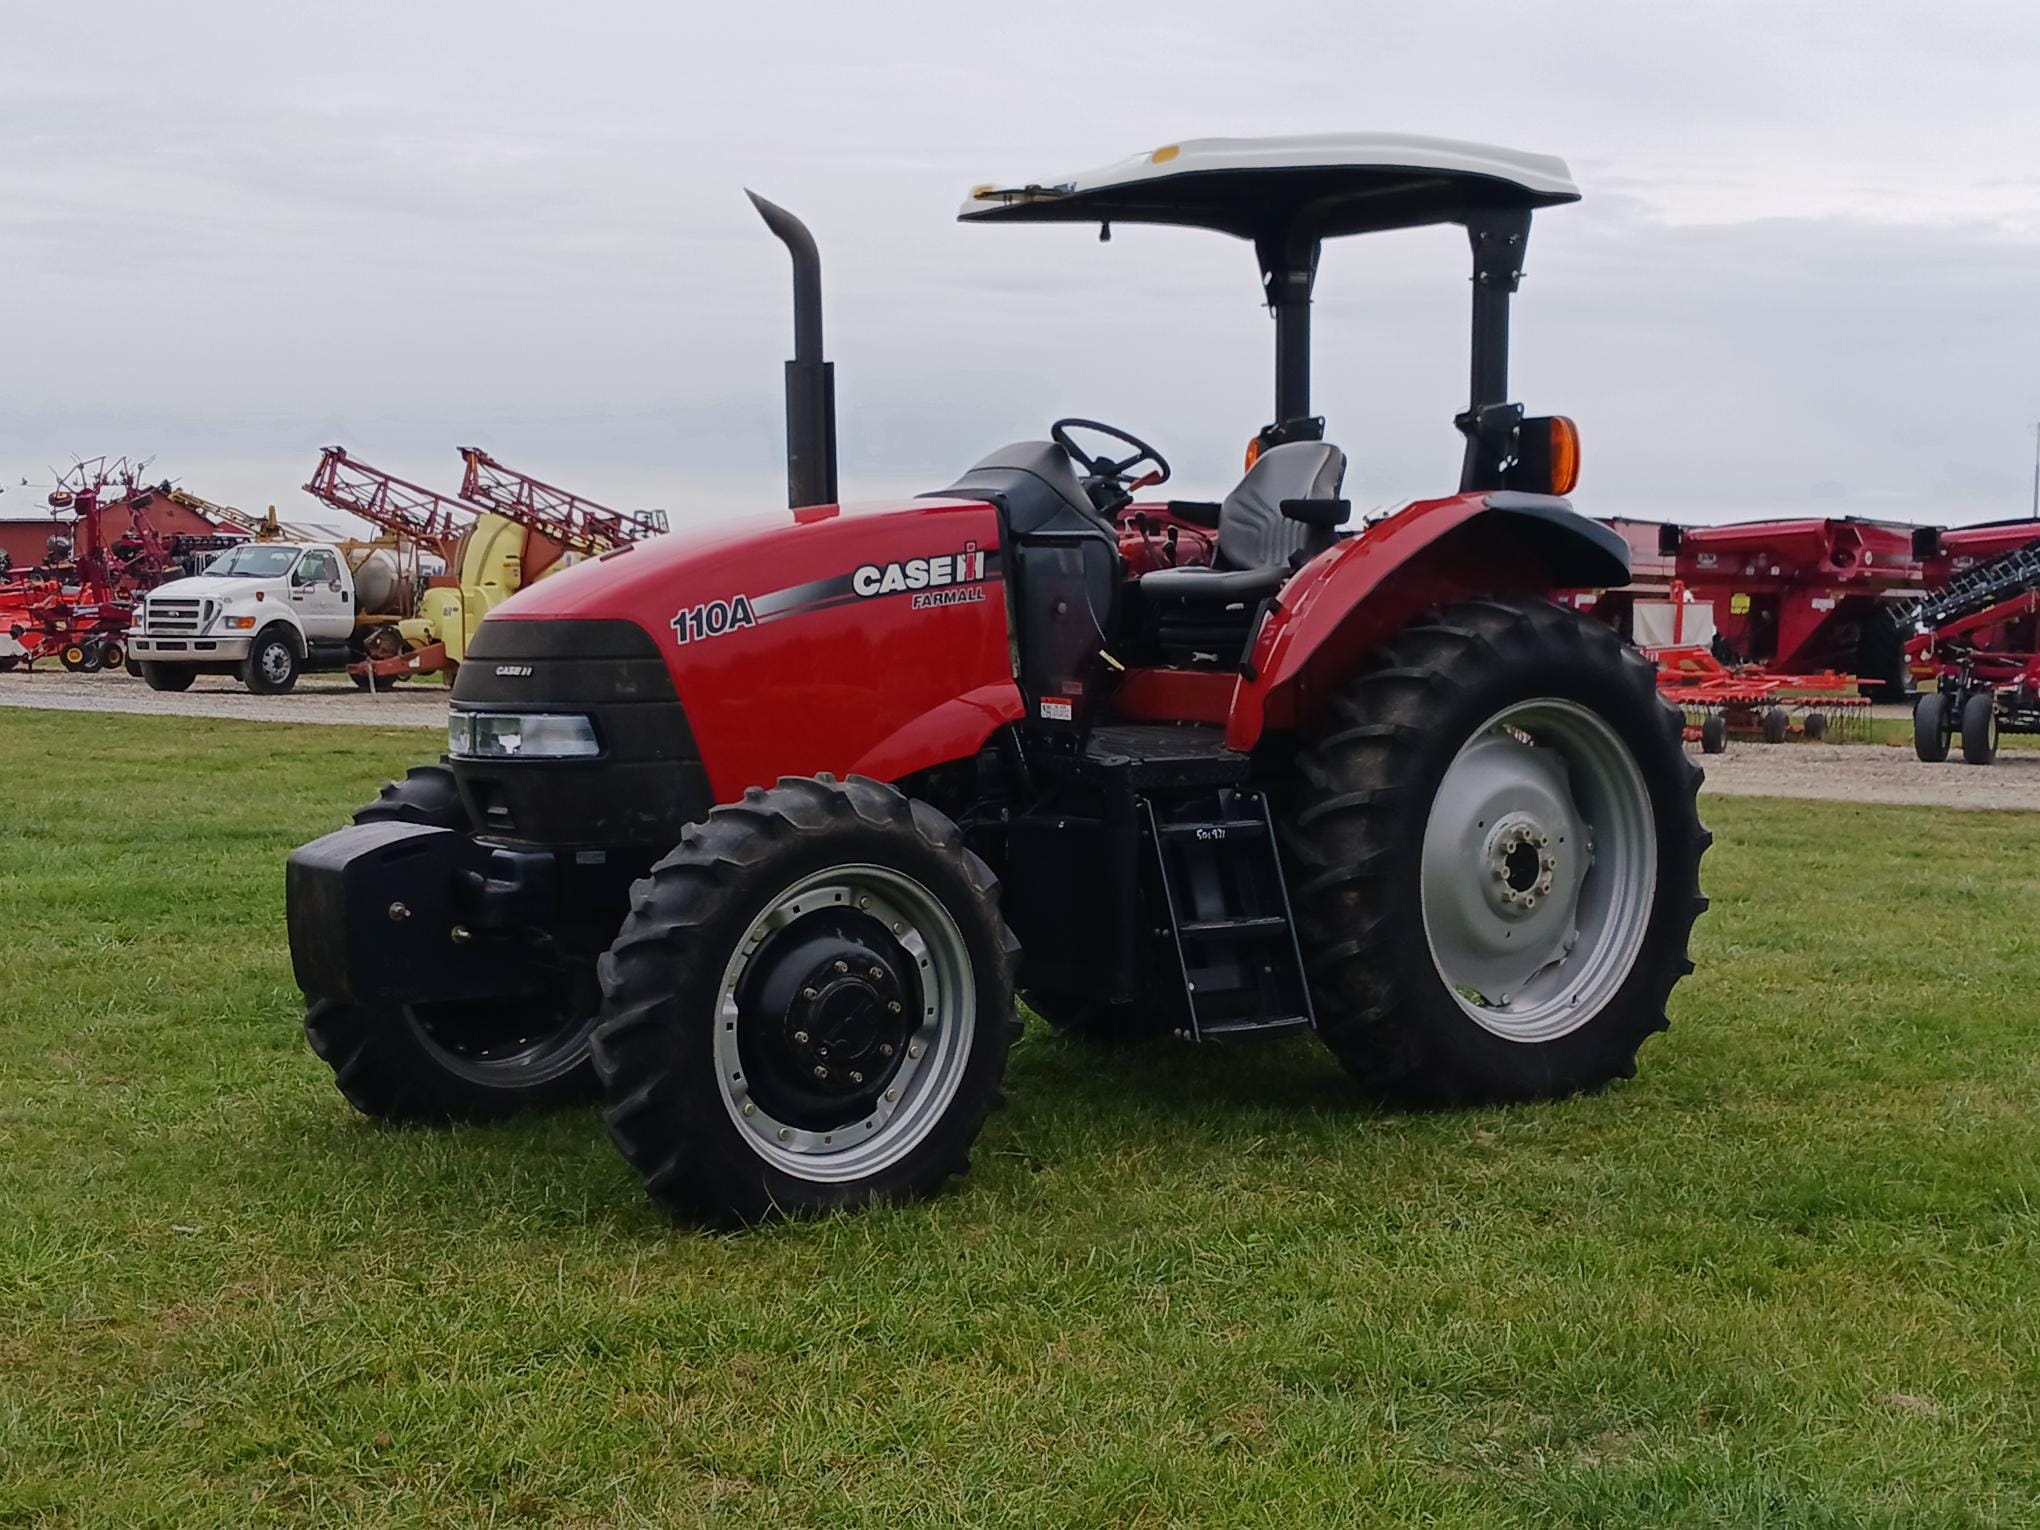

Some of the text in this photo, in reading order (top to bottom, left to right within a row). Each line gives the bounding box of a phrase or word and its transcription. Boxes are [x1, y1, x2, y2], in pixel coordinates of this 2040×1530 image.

[853, 556, 952, 597] CASE
[912, 587, 985, 609] FARMALL
[670, 594, 756, 645] 110A
